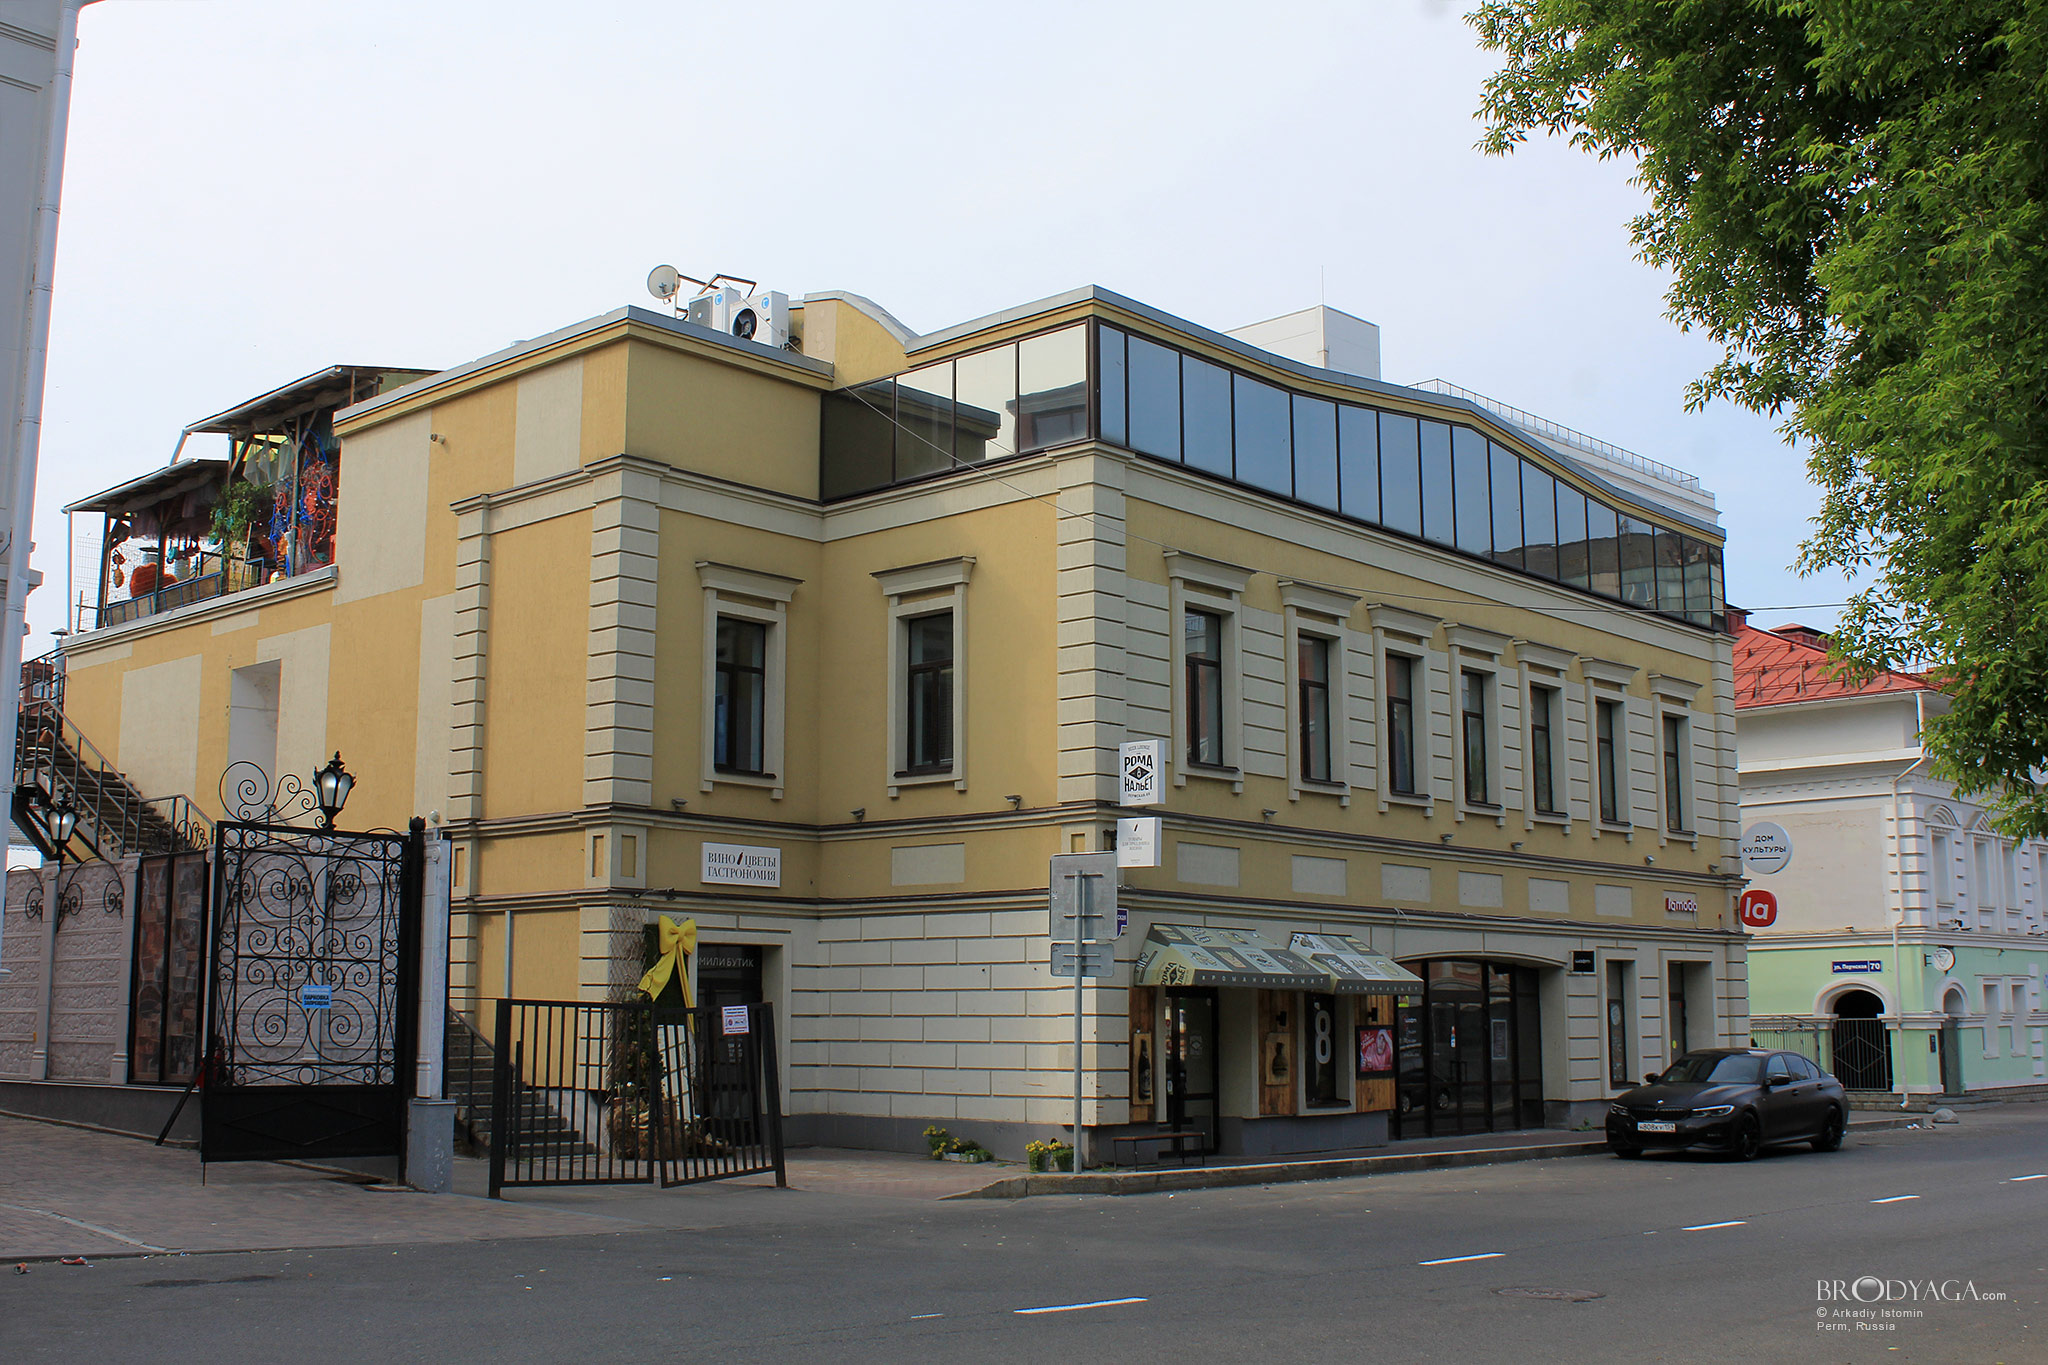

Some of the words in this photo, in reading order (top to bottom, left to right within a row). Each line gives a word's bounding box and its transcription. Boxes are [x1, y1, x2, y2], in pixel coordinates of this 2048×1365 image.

[1124, 754, 1154, 772] РОМА
[1754, 835, 1774, 843] ДОМ
[1742, 846, 1787, 854] КУЛЬТУРЫ
[708, 852, 736, 865] ВИНО
[745, 855, 776, 868] ЦВЕТЫ
[708, 866, 776, 881] ГАСТРОНОМИЯ
[1744, 896, 1769, 920] la
[726, 957, 754, 968] БУТИК
[1869, 962, 1881, 970] 70
